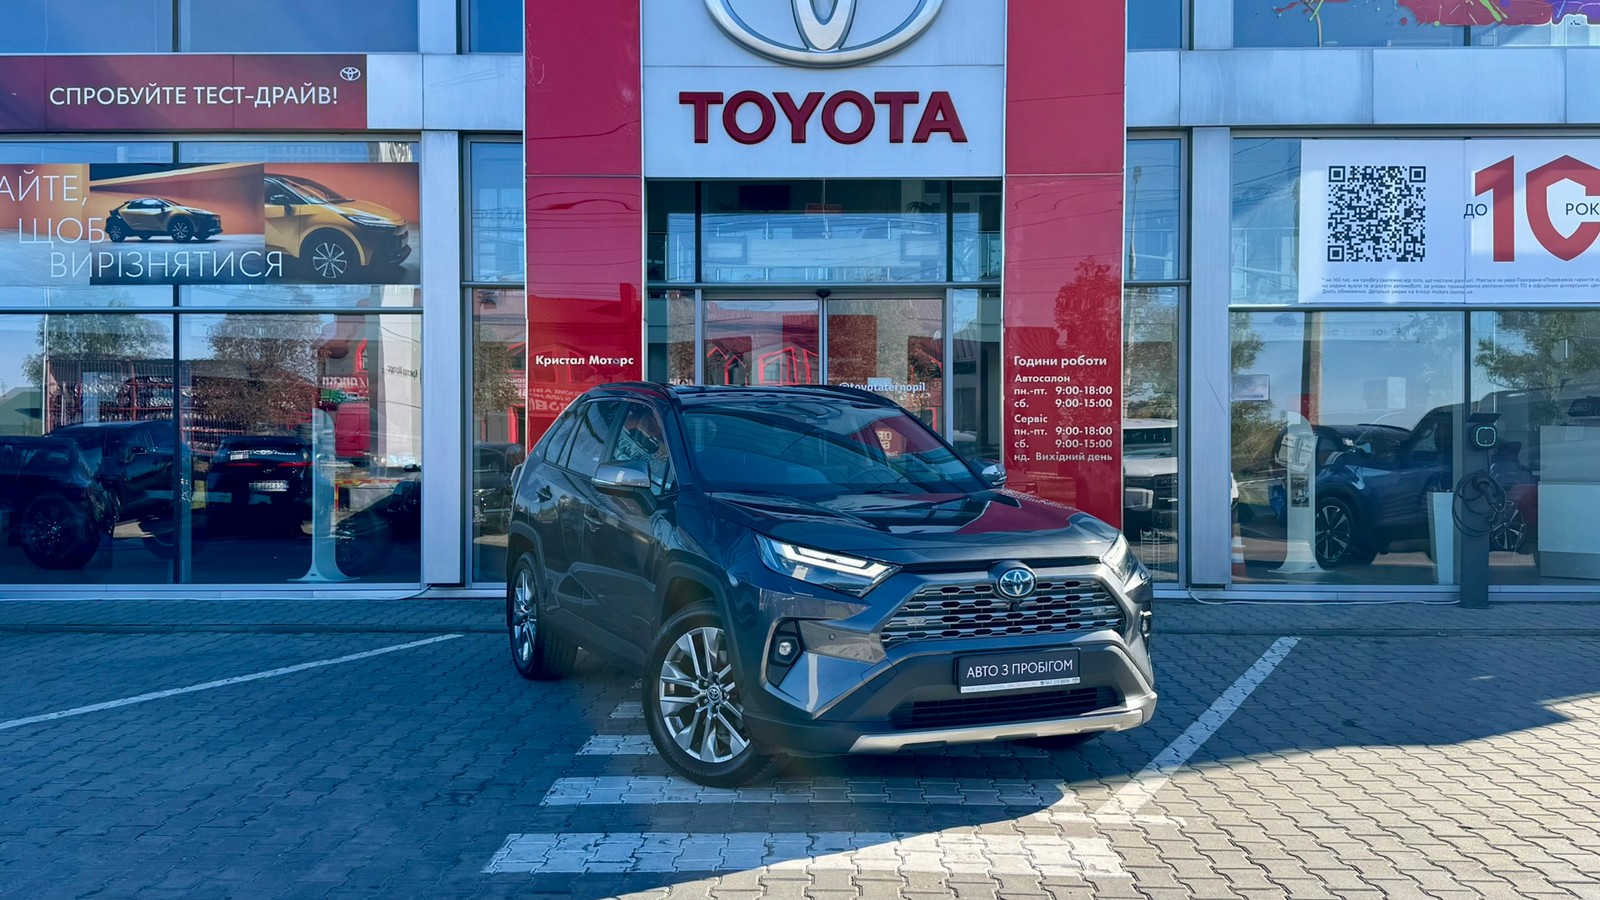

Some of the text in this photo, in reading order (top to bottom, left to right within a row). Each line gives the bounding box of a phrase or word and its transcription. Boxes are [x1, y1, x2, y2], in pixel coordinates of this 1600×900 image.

[49, 82, 338, 107] СПРОБУЙТЕ ТЕСТ-ДРАЙВ!
[679, 90, 968, 145] TOYOTA
[1463, 203, 1488, 219] ДО
[1565, 202, 1600, 216] РОК
[18, 217, 105, 249] ЩОБ
[50, 250, 282, 278] ВИРІЗНЯТИСЯ
[536, 355, 634, 368] Кристал Моторс
[1014, 355, 1107, 368] Години роботи
[1014, 374, 1071, 382] Автосалон
[1055, 386, 1112, 395] 9:00-18:00
[1014, 398, 1112, 407] сб. 9:00-15:00
[1014, 413, 1048, 425] Сервіс
[1014, 426, 1112, 436] пн.-пт. 9:00-18:00
[1014, 439, 1112, 448] сб. 9:00-15:00
[1014, 451, 1112, 462] нд. Вихідний день
[966, 664, 999, 679] АВТО
[1012, 659, 1074, 675] ПРОБІГОМ
